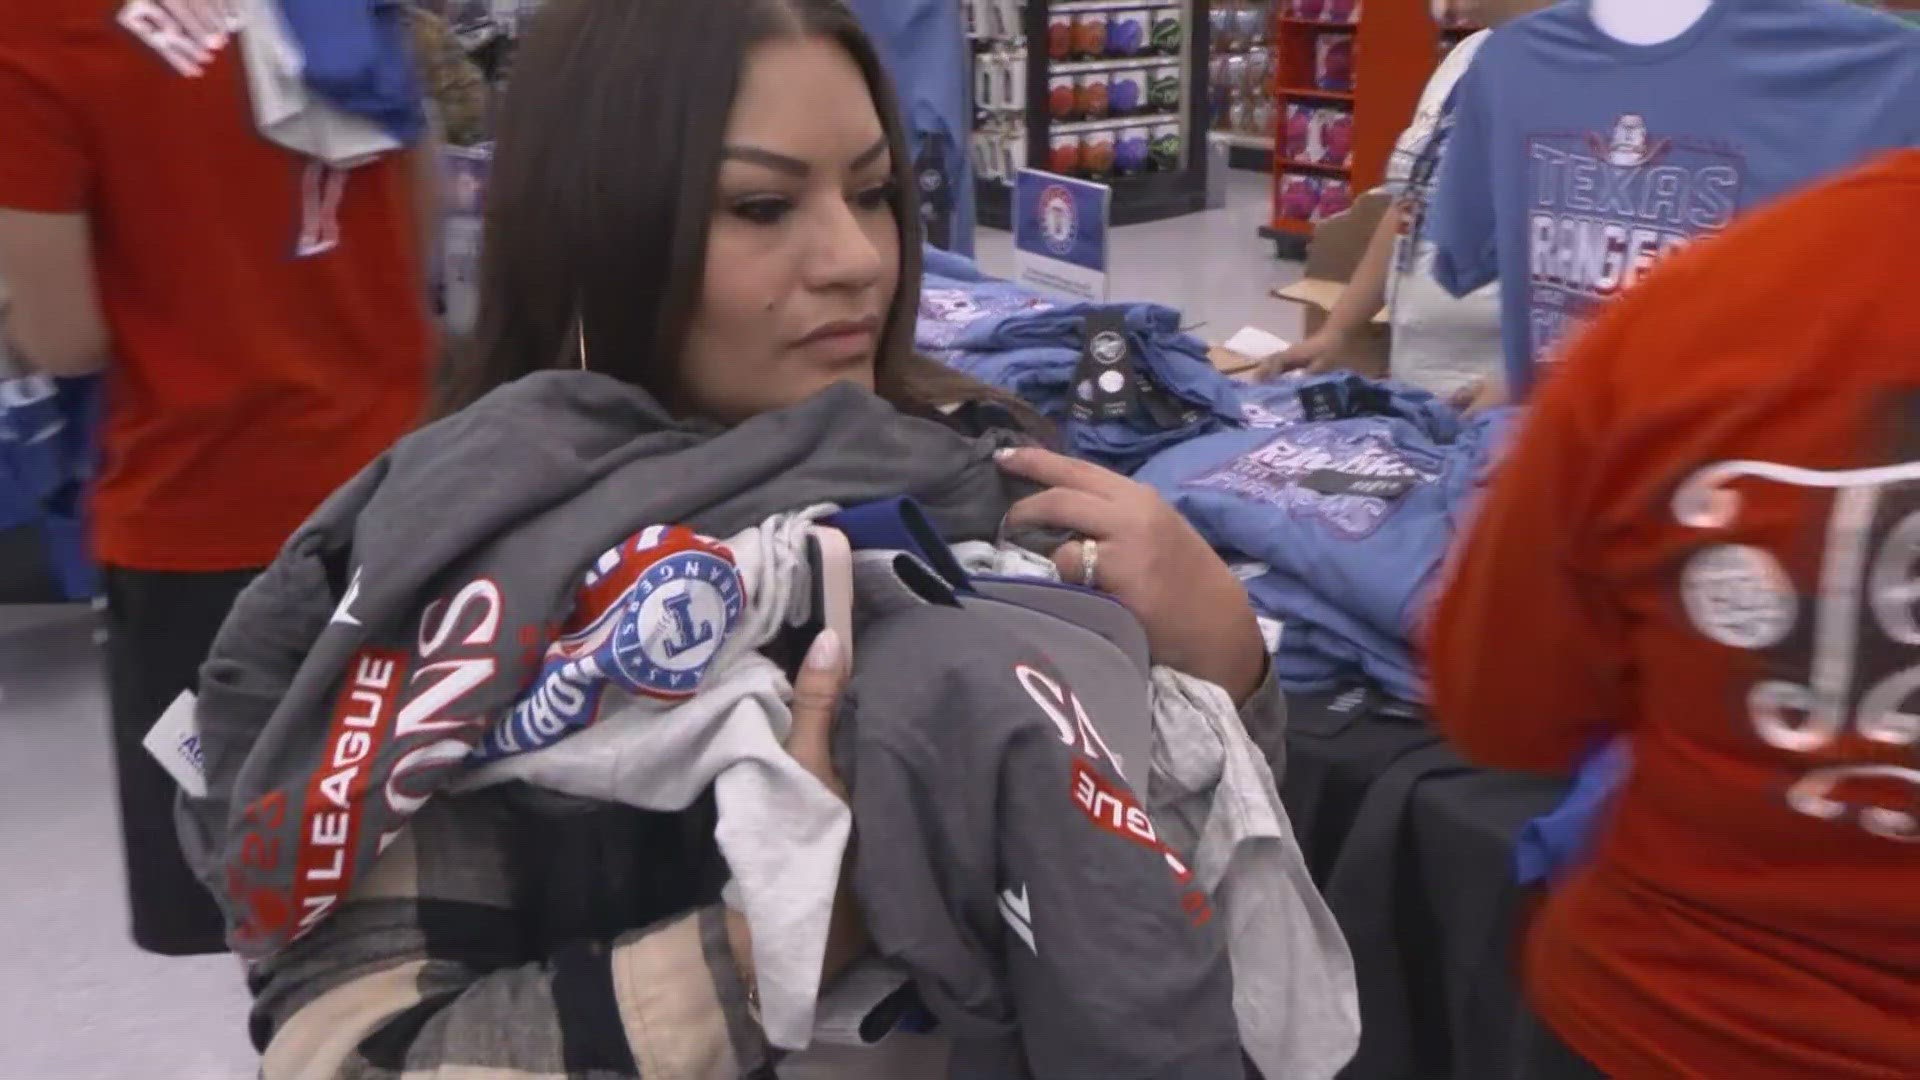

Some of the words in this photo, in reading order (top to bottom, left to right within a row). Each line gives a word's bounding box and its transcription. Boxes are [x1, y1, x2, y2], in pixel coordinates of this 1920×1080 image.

[1531, 143, 1740, 229] TEXAS
[306, 655, 395, 881] LEAGUE
[378, 578, 500, 856] ONS
